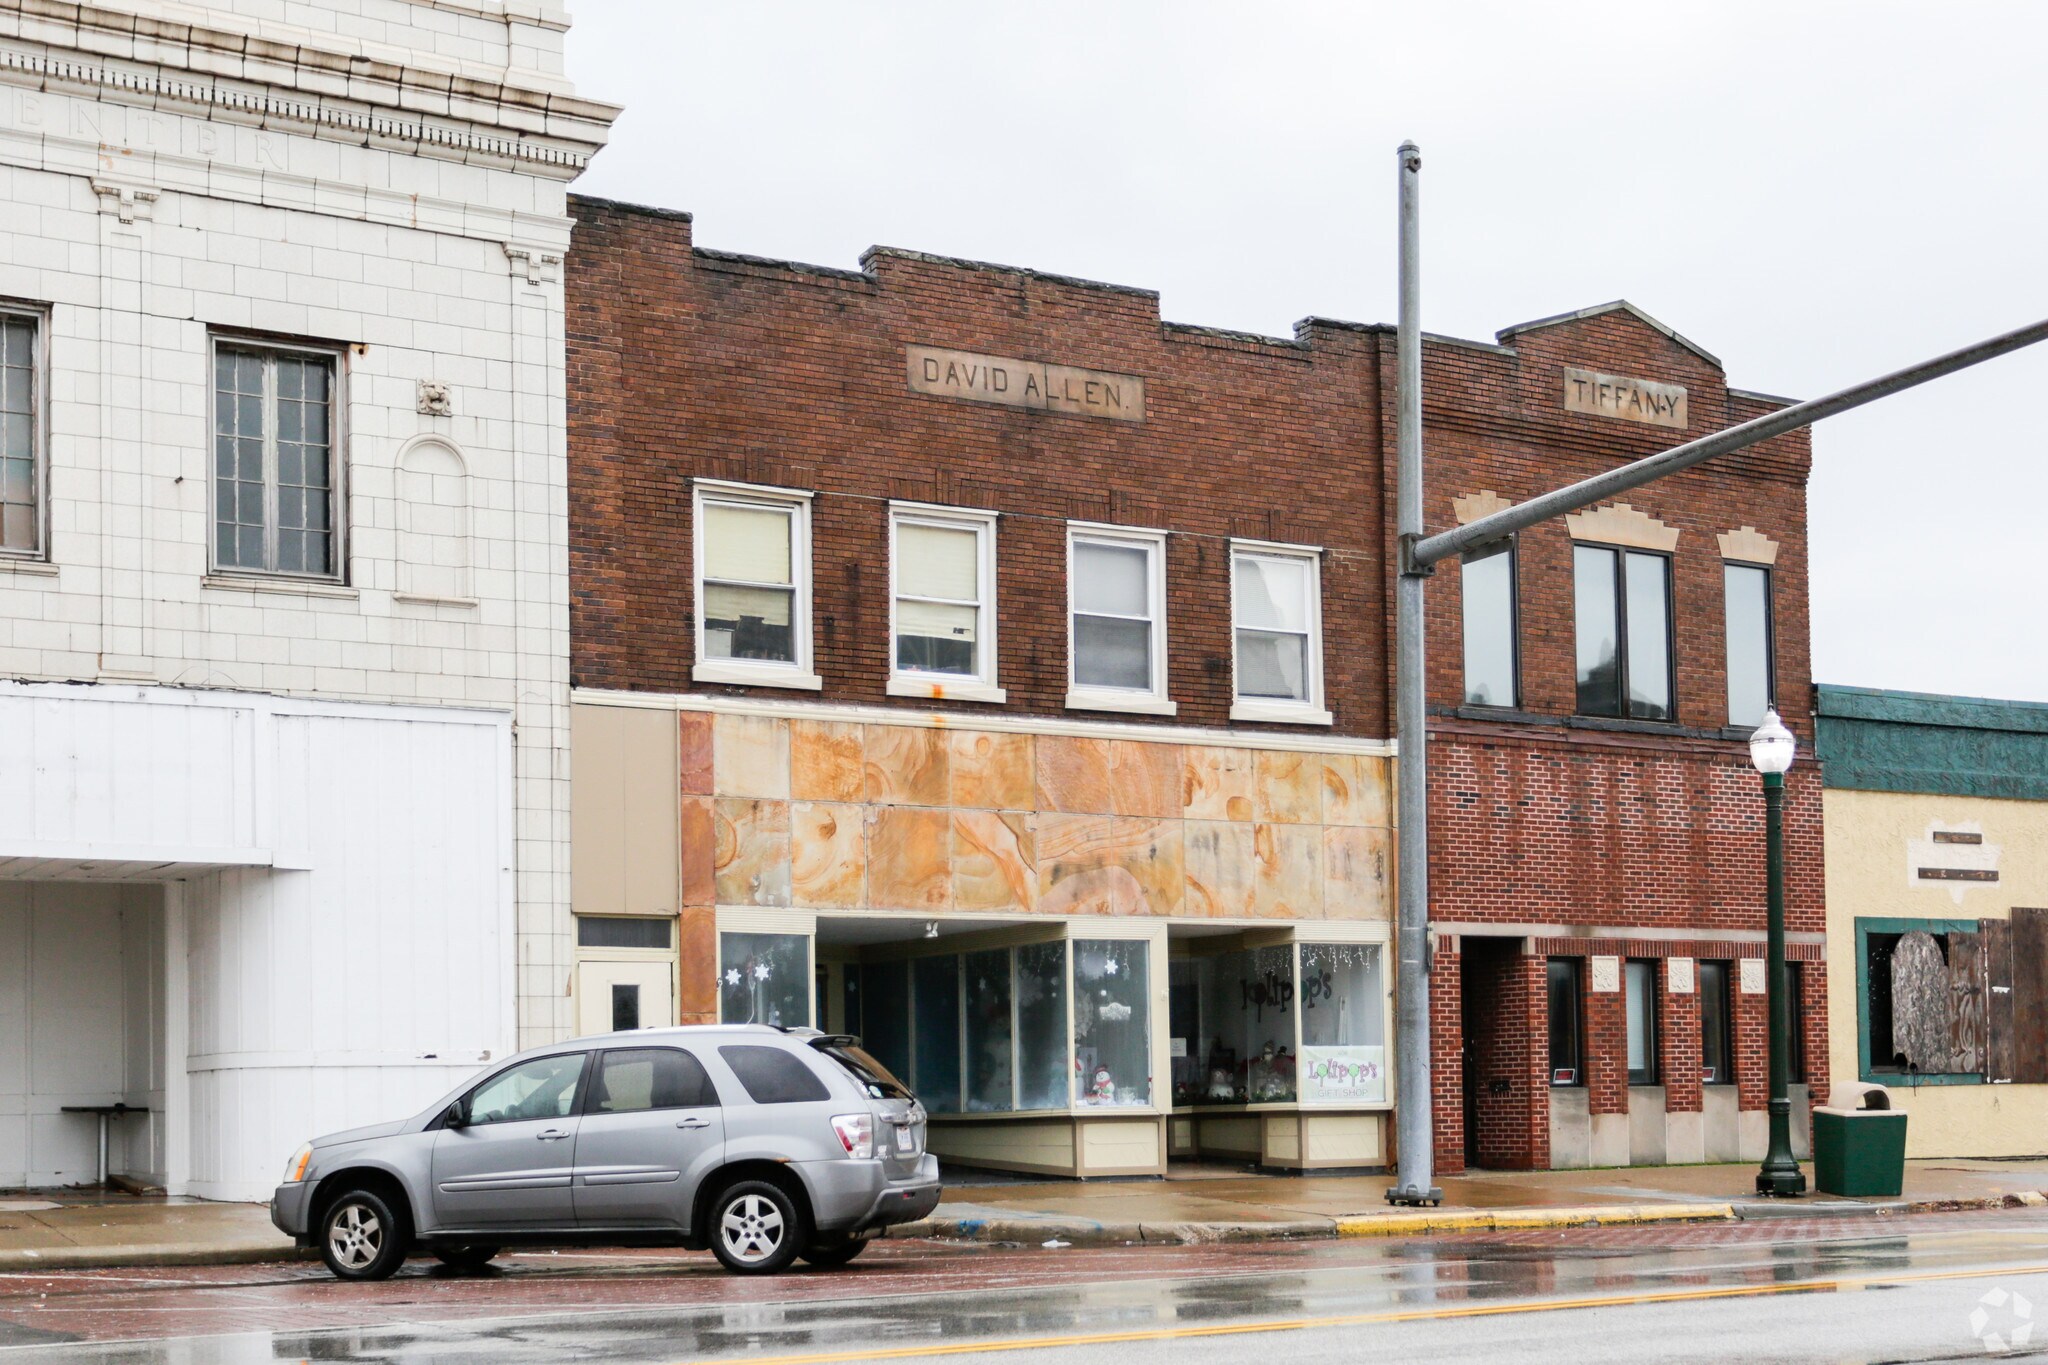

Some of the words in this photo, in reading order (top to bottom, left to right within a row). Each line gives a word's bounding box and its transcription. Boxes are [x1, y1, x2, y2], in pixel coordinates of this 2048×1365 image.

[923, 357, 1008, 393] DAVID
[1572, 378, 1680, 418] TIFFANY
[1317, 1089, 1339, 1098] GIFT
[1343, 1089, 1368, 1097] SHOP
